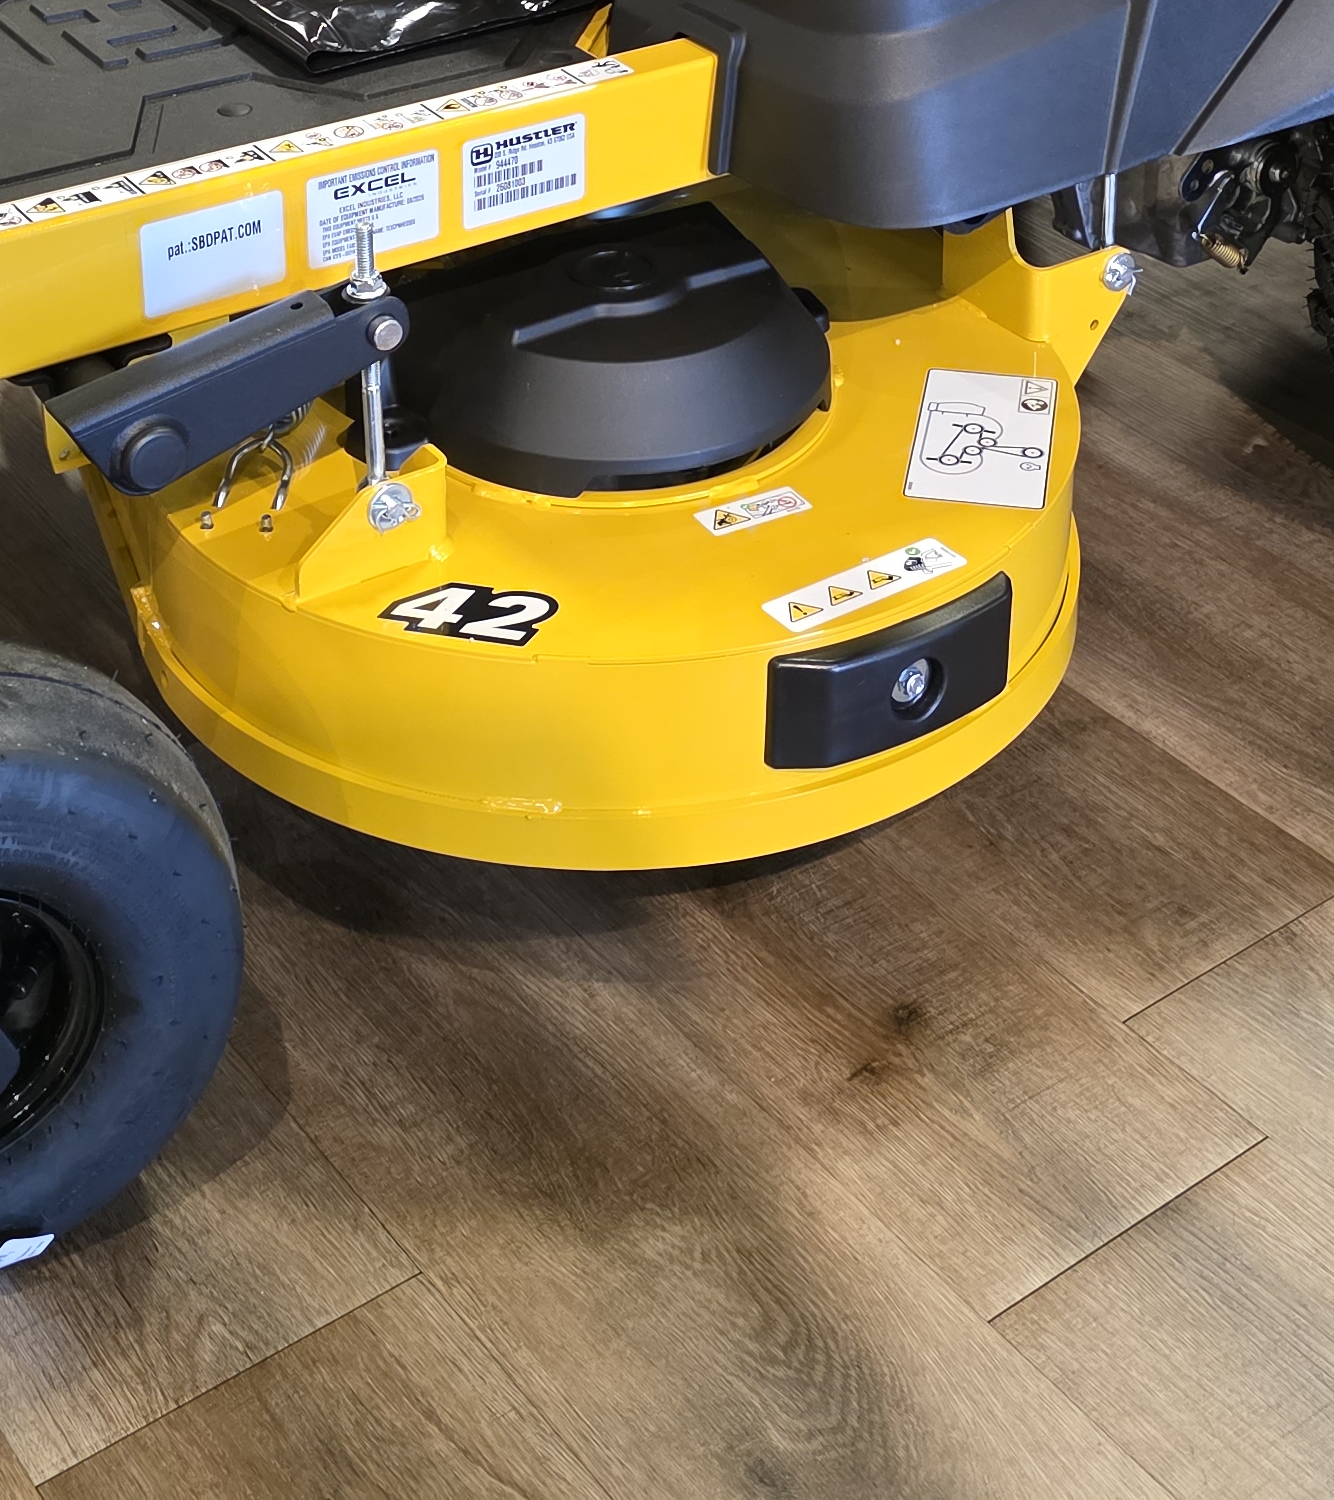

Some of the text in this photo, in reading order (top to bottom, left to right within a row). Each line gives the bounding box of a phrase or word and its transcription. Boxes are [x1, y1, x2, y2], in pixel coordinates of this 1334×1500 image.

[495, 122, 576, 150] HUSTLER
[318, 153, 435, 190] IMPORTANT EMISSIONS CONTROL INFORMATION
[496, 156, 519, 170] 944470
[333, 172, 416, 200] EXCEL
[339, 203, 356, 214] EXCEL
[393, 192, 404, 201] LLC
[319, 217, 332, 227] DATE
[333, 215, 339, 224] OF
[389, 587, 550, 641] 42
